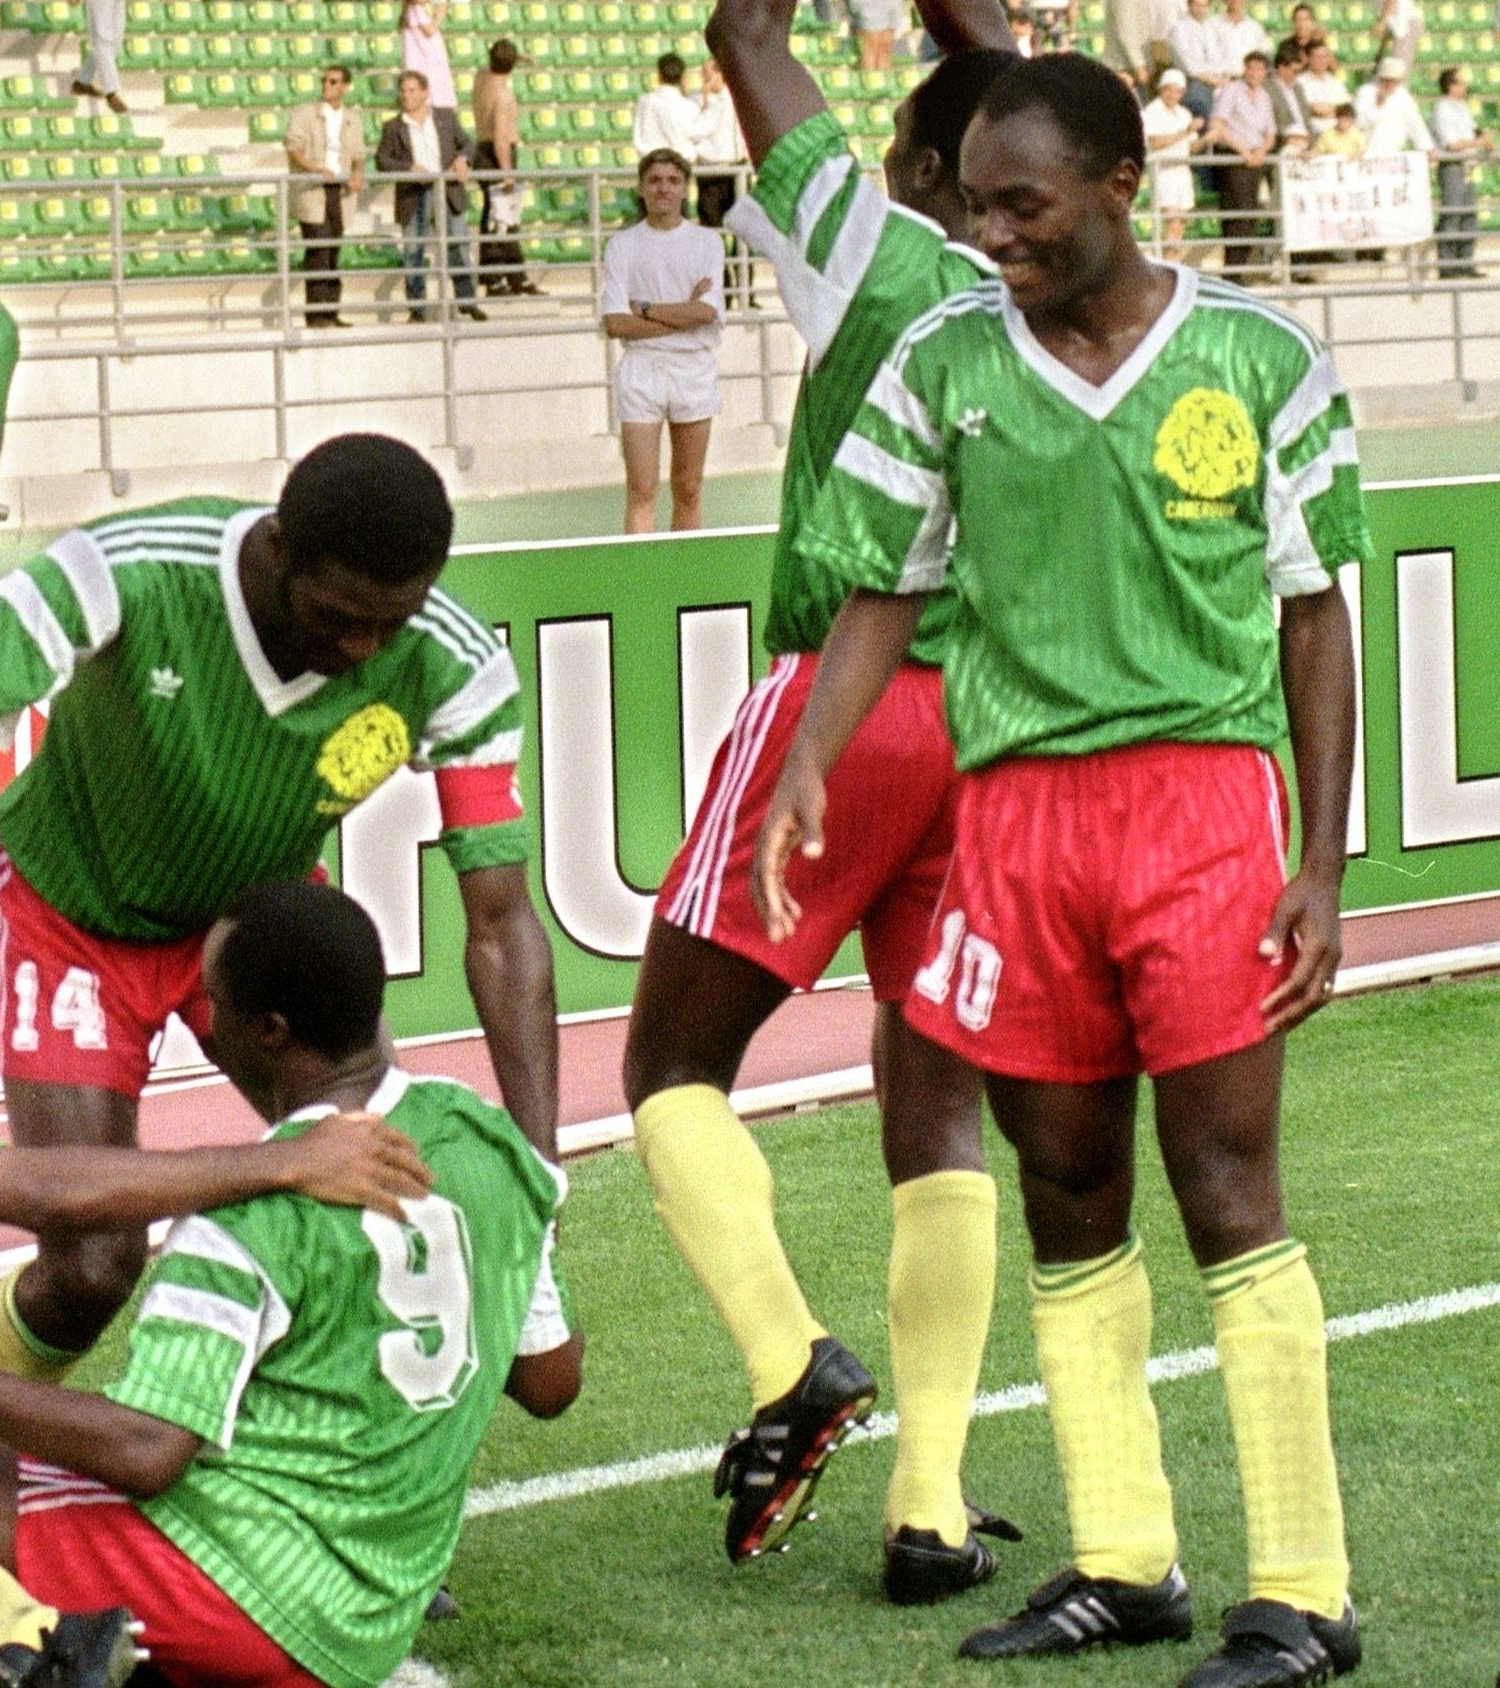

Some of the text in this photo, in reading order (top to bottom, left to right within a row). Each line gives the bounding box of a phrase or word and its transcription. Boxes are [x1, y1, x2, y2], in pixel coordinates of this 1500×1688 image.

[11, 959, 108, 1051] 14
[914, 908, 1003, 1032] 10
[361, 1193, 479, 1412] 9
